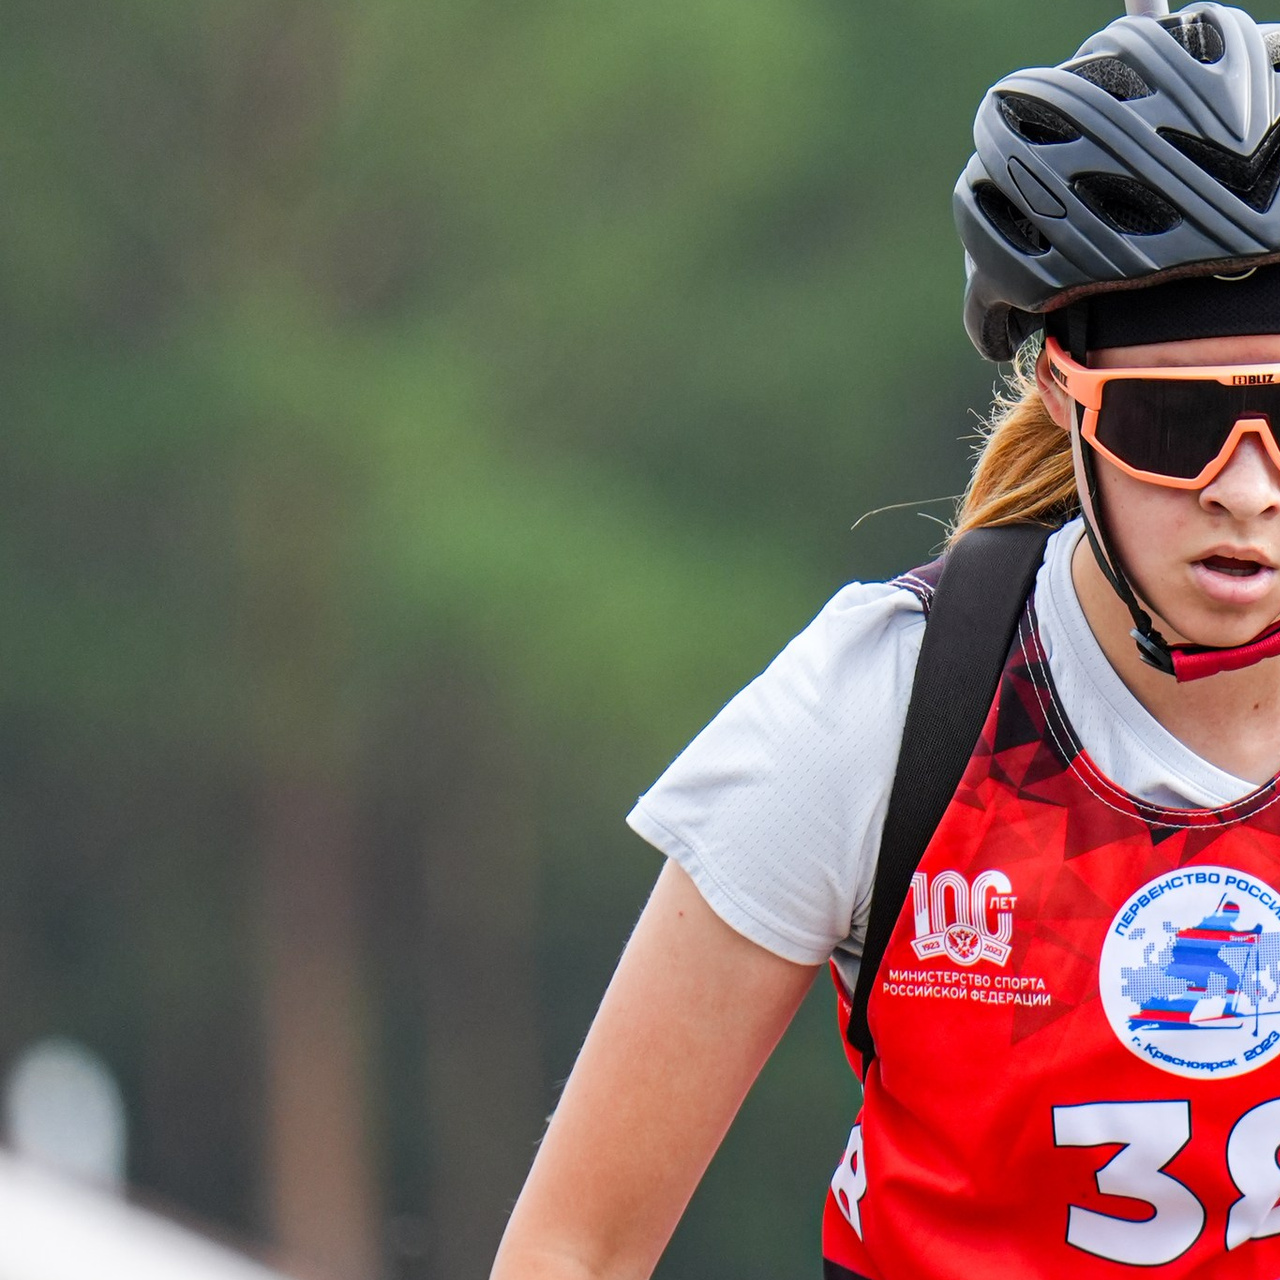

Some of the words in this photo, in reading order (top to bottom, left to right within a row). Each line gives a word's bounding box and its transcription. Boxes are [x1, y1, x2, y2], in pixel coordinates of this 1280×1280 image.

[1248, 373, 1275, 385] BLIZ
[909, 869, 1013, 944] 100
[989, 896, 1018, 910] ЛЕТ
[1115, 872, 1221, 936] ПЕРВЕНСТВО
[921, 941, 941, 952] 1923
[983, 943, 1003, 957] 2023
[889, 969, 991, 987] МИНИСТЕРСТВО
[994, 975, 1046, 990] СПОРТА
[882, 982, 968, 1000] РОССИЙСКОЙ
[970, 990, 1052, 1007] ФЕДЕРАЦИИ
[1131, 1035, 1142, 1048] г.
[1143, 1042, 1238, 1072] Красноярск
